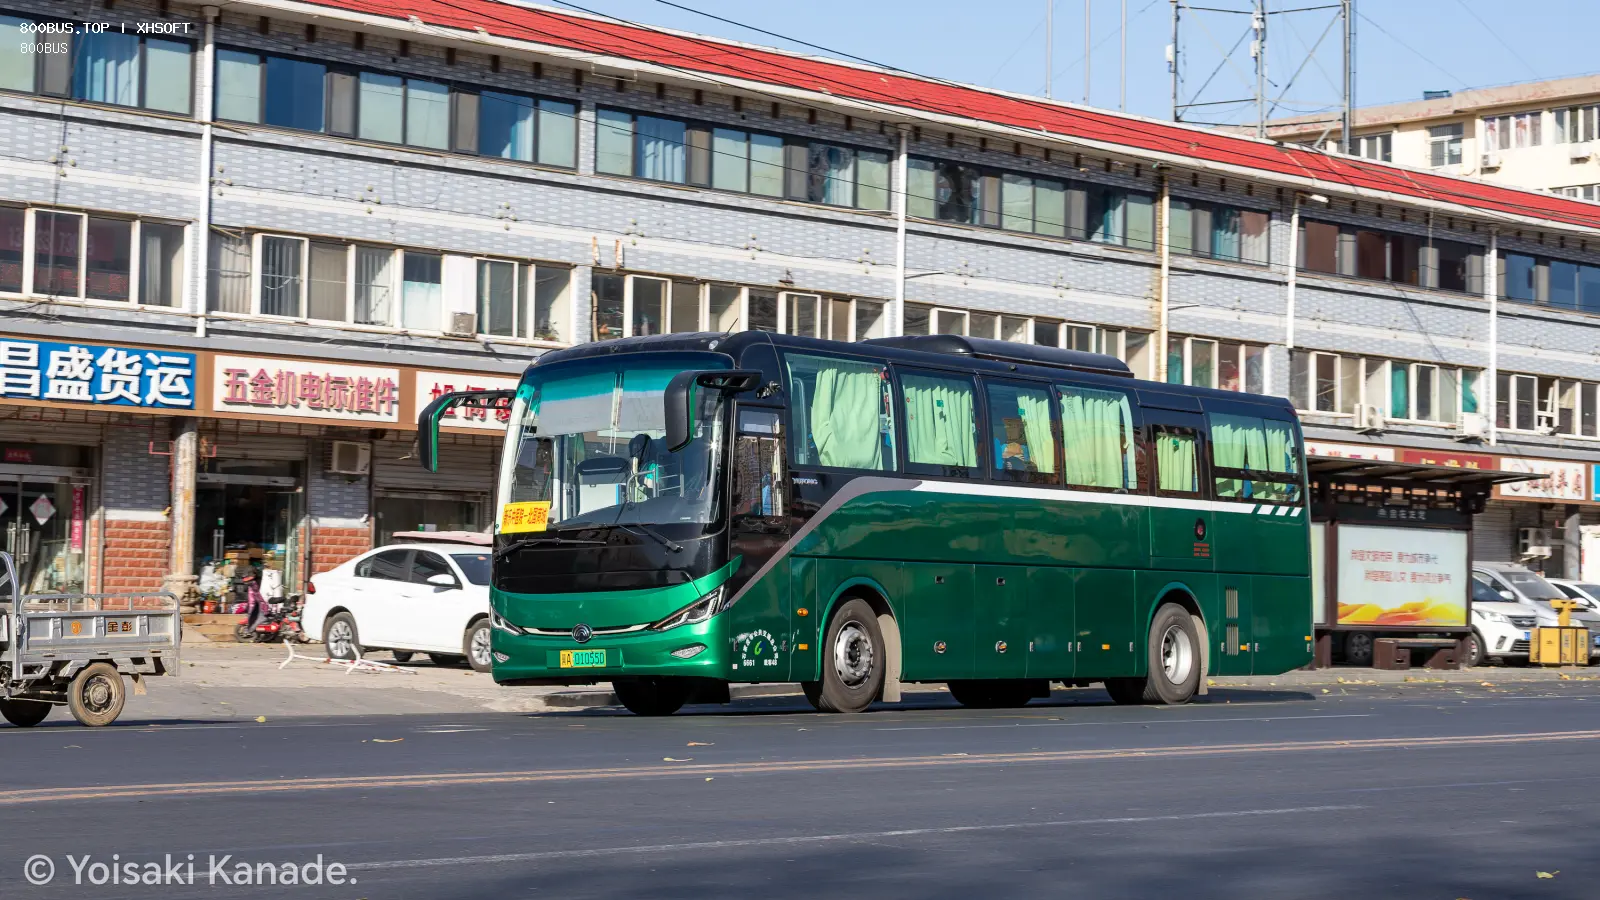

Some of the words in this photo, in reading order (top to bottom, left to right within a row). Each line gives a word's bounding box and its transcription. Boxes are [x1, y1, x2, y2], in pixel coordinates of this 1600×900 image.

[0, 341, 192, 406] 昌盛货运
[223, 368, 397, 415] 五金机电标准件
[107, 621, 133, 633] 金彭
